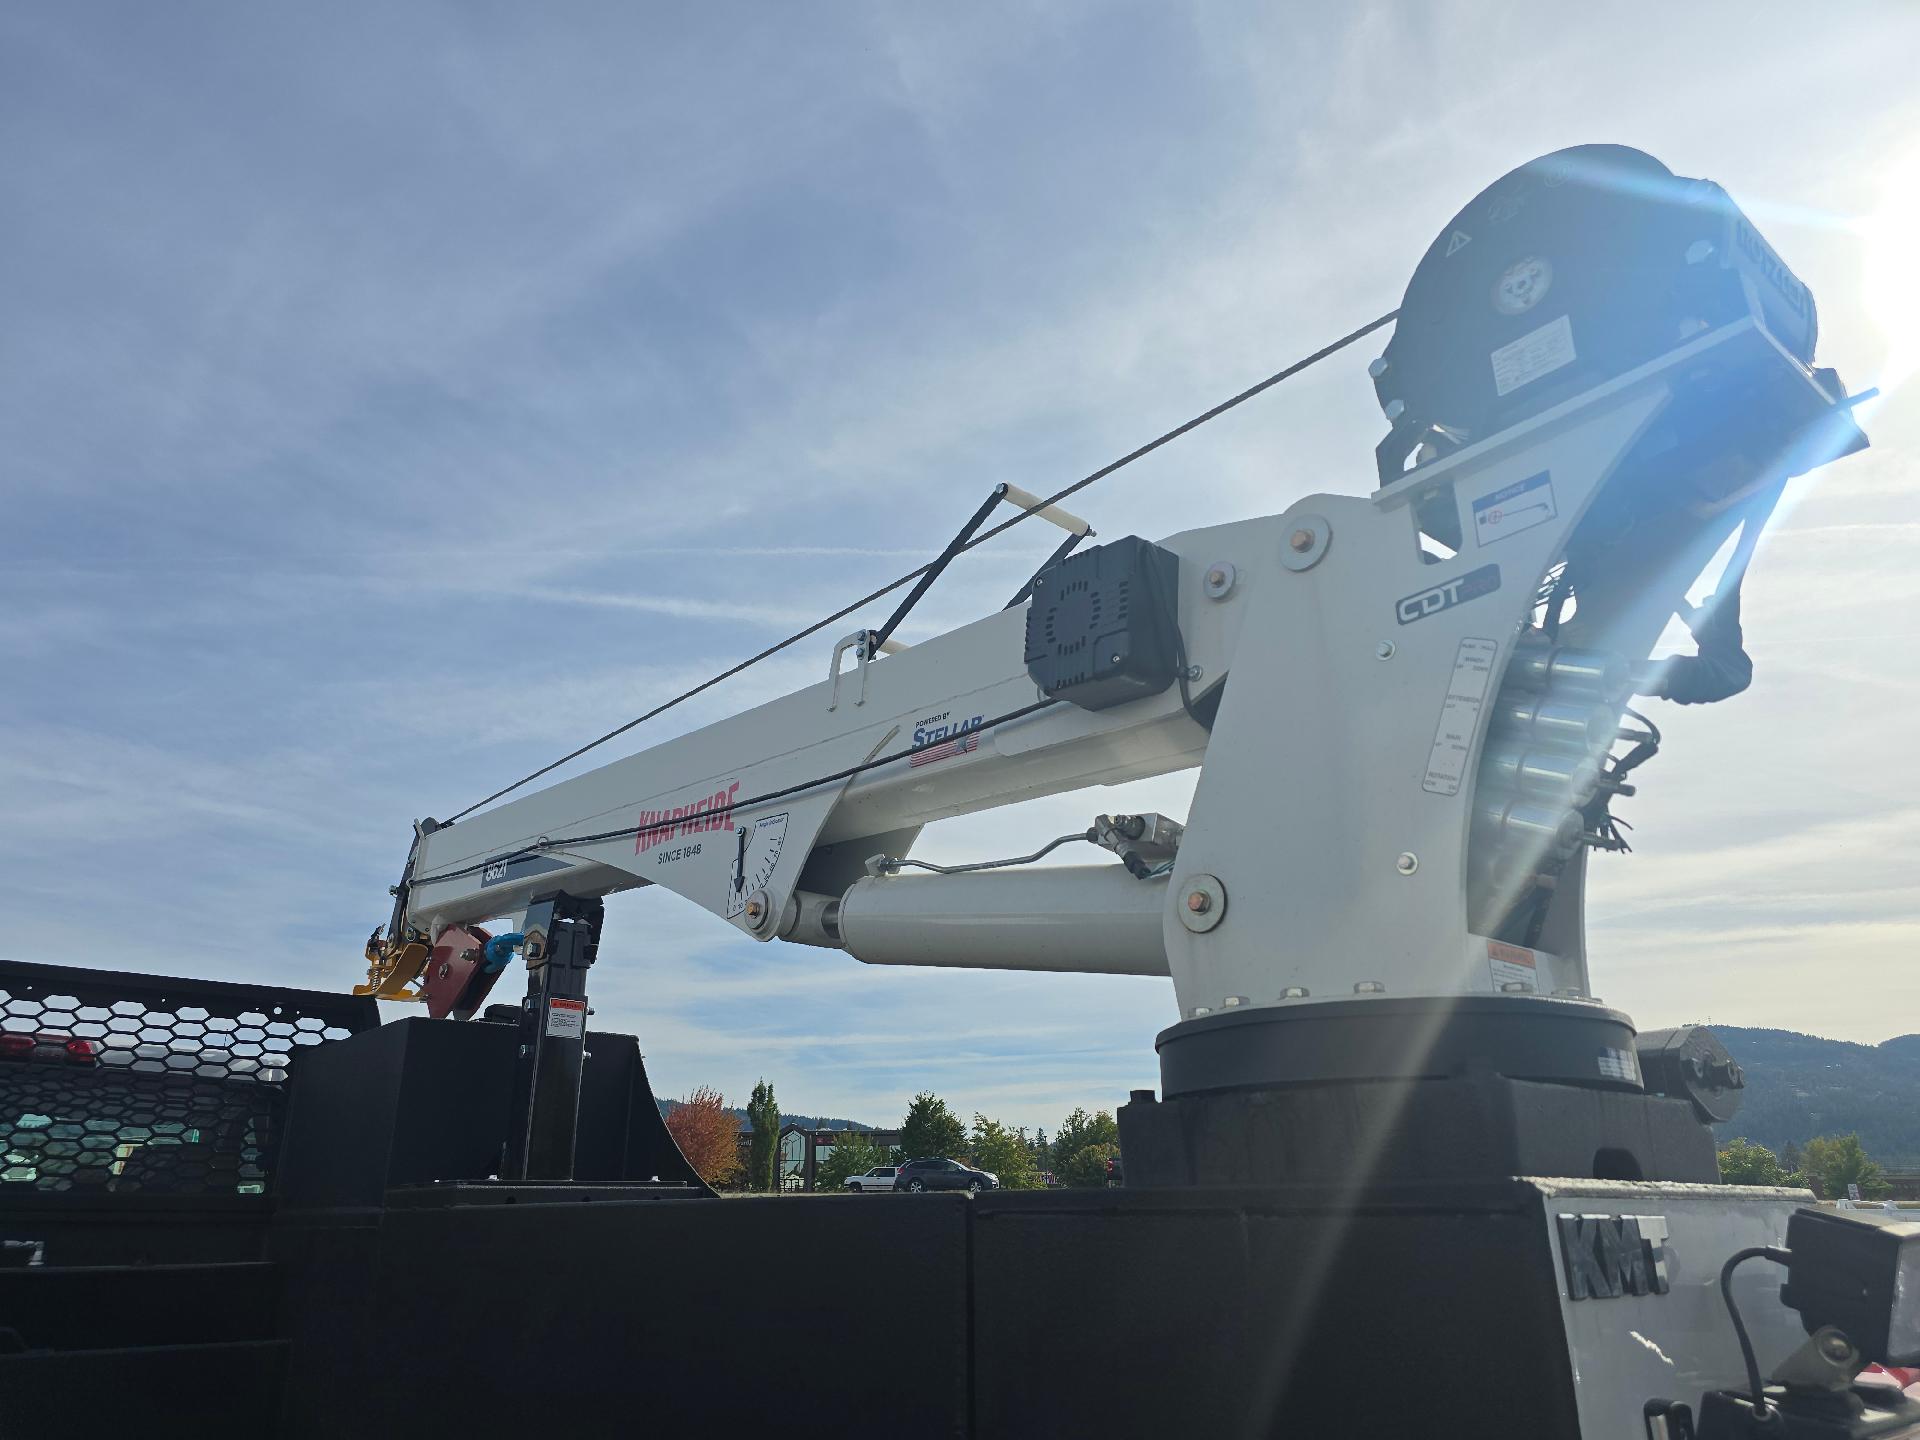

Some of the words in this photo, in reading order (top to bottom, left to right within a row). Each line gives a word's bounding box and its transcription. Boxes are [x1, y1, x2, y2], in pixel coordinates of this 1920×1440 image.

[1399, 578, 1465, 622] CDT
[915, 714, 942, 728] POWERED
[942, 711, 951, 720] BY
[634, 780, 740, 856] KNAPHEIDE
[657, 848, 682, 865] SINCE
[683, 843, 702, 860] 1848
[1557, 1213, 1670, 1301] KMT
